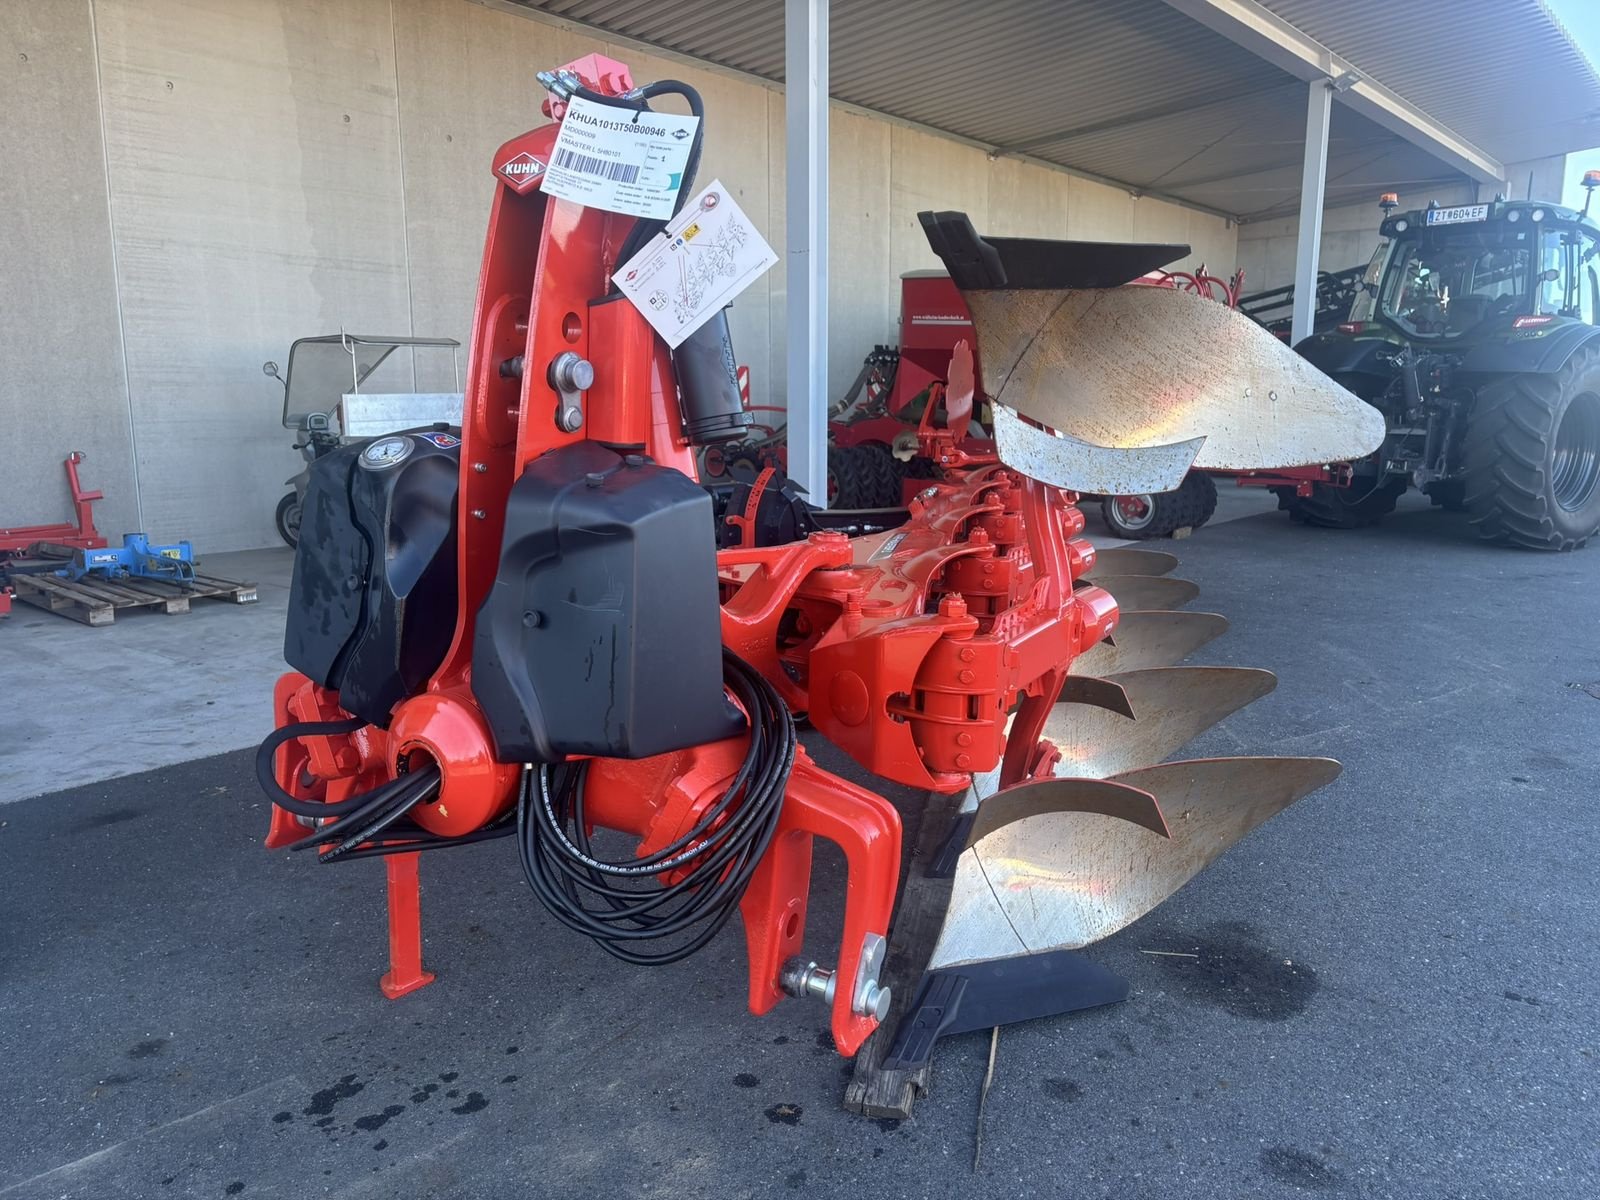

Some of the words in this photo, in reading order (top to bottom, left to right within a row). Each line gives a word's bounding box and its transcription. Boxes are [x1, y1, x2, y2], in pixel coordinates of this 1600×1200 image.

[569, 110, 666, 137] KHUA1013T50B00946
[505, 163, 539, 174] KUHN
[1435, 211, 1447, 221] ZT
[1452, 209, 1470, 219] 604
[1471, 207, 1484, 217] EF
